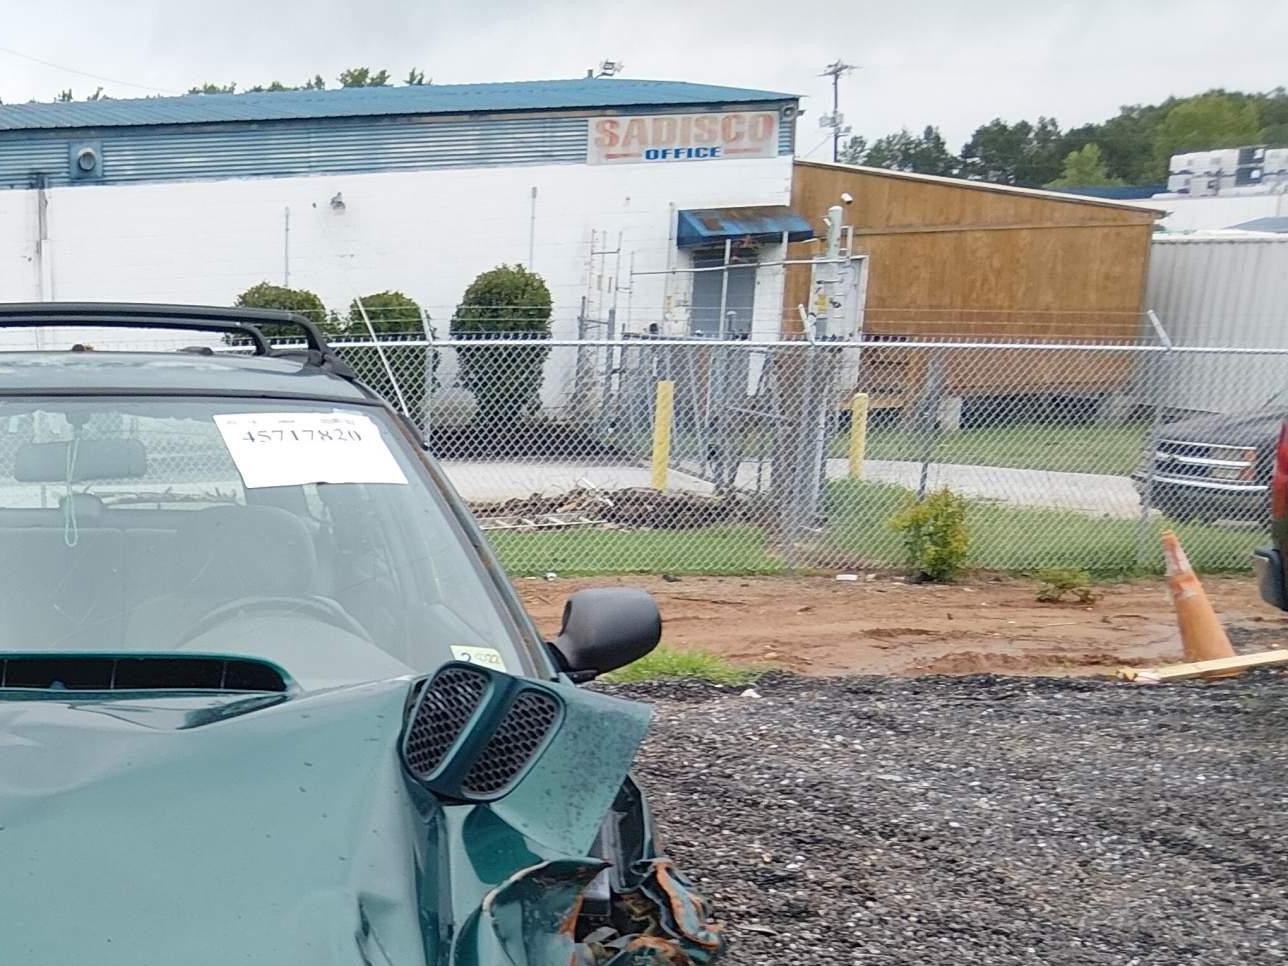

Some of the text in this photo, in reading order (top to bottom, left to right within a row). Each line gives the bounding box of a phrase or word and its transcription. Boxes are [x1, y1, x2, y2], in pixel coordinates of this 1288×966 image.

[595, 114, 774, 147] SADISCO
[645, 146, 721, 160] OFFICE
[242, 428, 362, 442] 45717820
